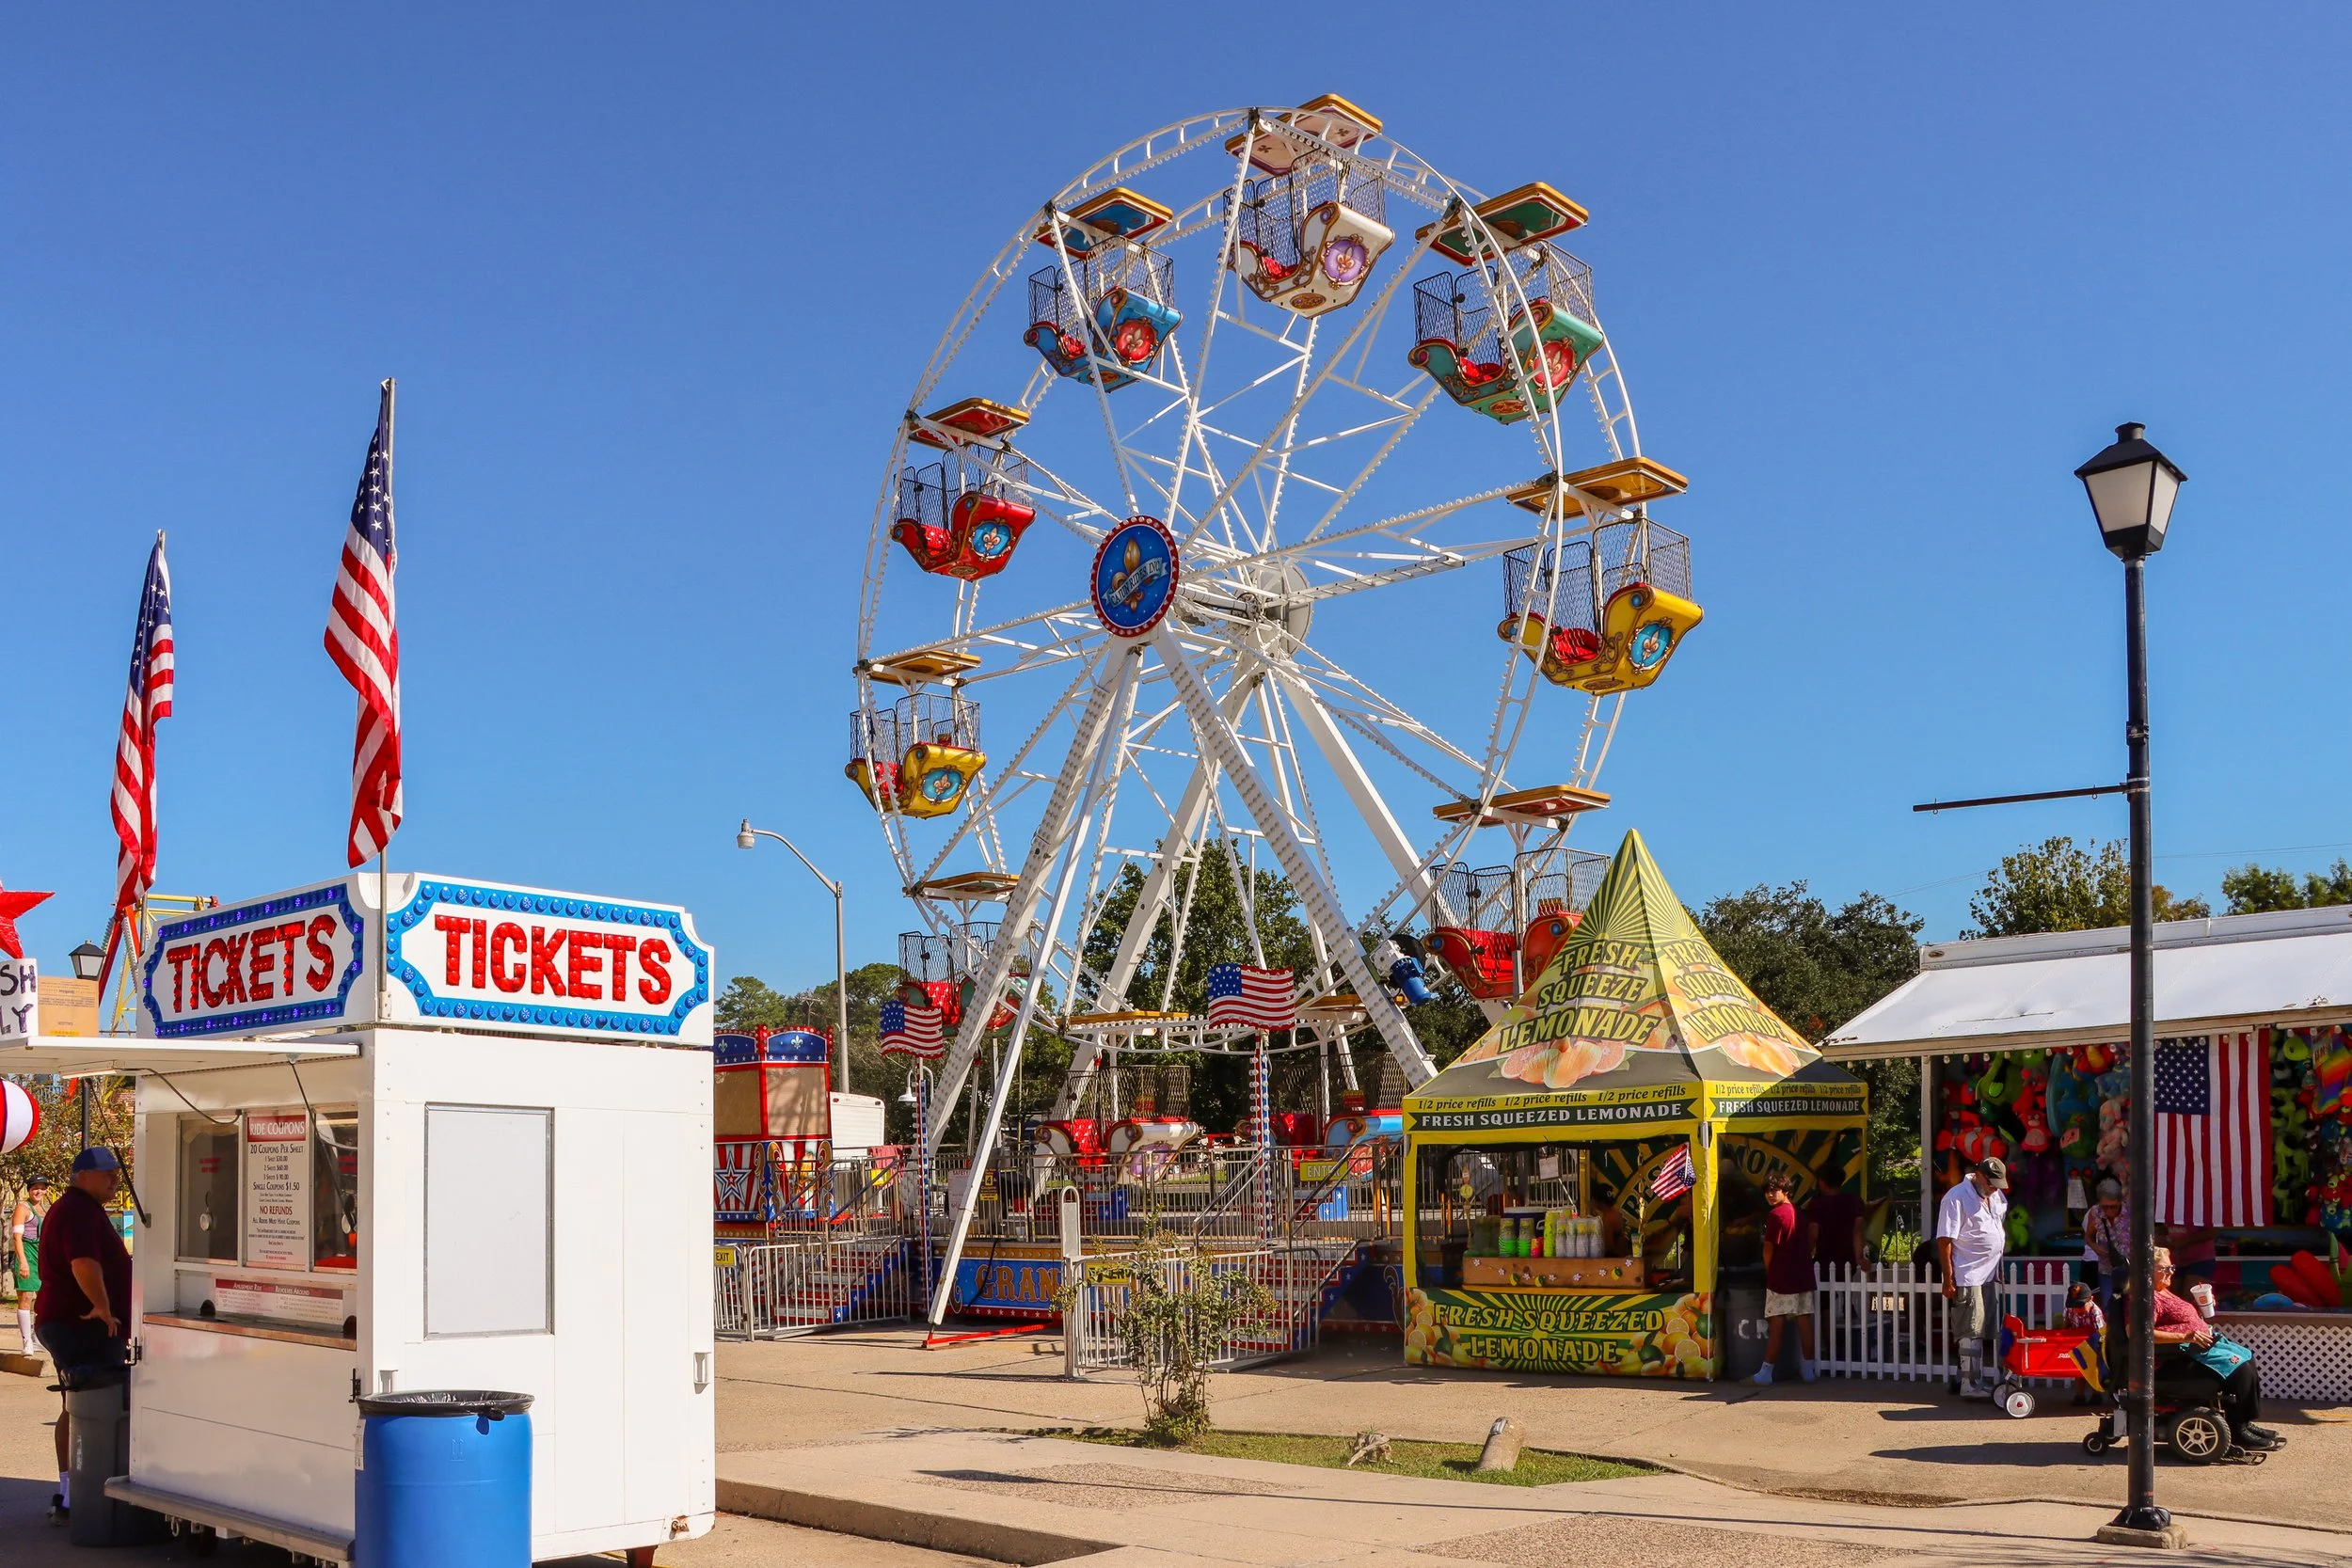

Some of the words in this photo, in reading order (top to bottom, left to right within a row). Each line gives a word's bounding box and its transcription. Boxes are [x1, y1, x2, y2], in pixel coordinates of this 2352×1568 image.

[1111, 583, 1129, 605] CAJUN
[1149, 560, 1160, 573] INC
[166, 914, 337, 1013] TICKETS
[435, 914, 672, 1005] TICKETS
[1562, 941, 1643, 975] FRESH
[1664, 941, 1724, 972] FRESH
[1537, 972, 1647, 1010] SQUEEZE
[1499, 1006, 1661, 1053] LEMONADE
[1683, 1006, 1791, 1045] LEMONADE
[1419, 1101, 1433, 1109] 1/2
[1435, 1100, 1464, 1111] price
[1466, 1098, 1496, 1109] refills
[1505, 1097, 1520, 1107] 1/2
[1523, 1094, 1550, 1108] price
[1552, 1093, 1587, 1104] refills
[1598, 1091, 1615, 1102] 1/2
[1617, 1089, 1649, 1103] price
[1652, 1085, 1686, 1099] refills
[1727, 1085, 1744, 1095] price
[1746, 1084, 1764, 1095] refills
[1781, 1085, 1798, 1095] price
[1799, 1084, 1816, 1095] refills
[1828, 1085, 1844, 1095] price
[1845, 1084, 1861, 1095] refills
[1422, 1114, 1474, 1127] FRESH
[1480, 1109, 1570, 1126] SQUEEZED
[1577, 1103, 1682, 1121] LEMONADE
[1719, 1101, 1754, 1113] FRESH
[1756, 1100, 1808, 1113] SQUEEZED
[1811, 1100, 1859, 1112] LEMONADE
[249, 1123, 266, 1136] RIDE
[268, 1121, 305, 1135] COUPONS
[250, 1144, 257, 1154] 20
[286, 1182, 300, 1191] $1.50
[987, 1176, 991, 1184] 4
[259, 1205, 268, 1215] NO
[269, 1206, 293, 1215] REFUNDS
[716, 1252, 729, 1261] EXIT
[1435, 1304, 1515, 1328] FRESH
[1521, 1309, 1664, 1333] SQUEEZED
[1470, 1336, 1618, 1363] LEMONADE
